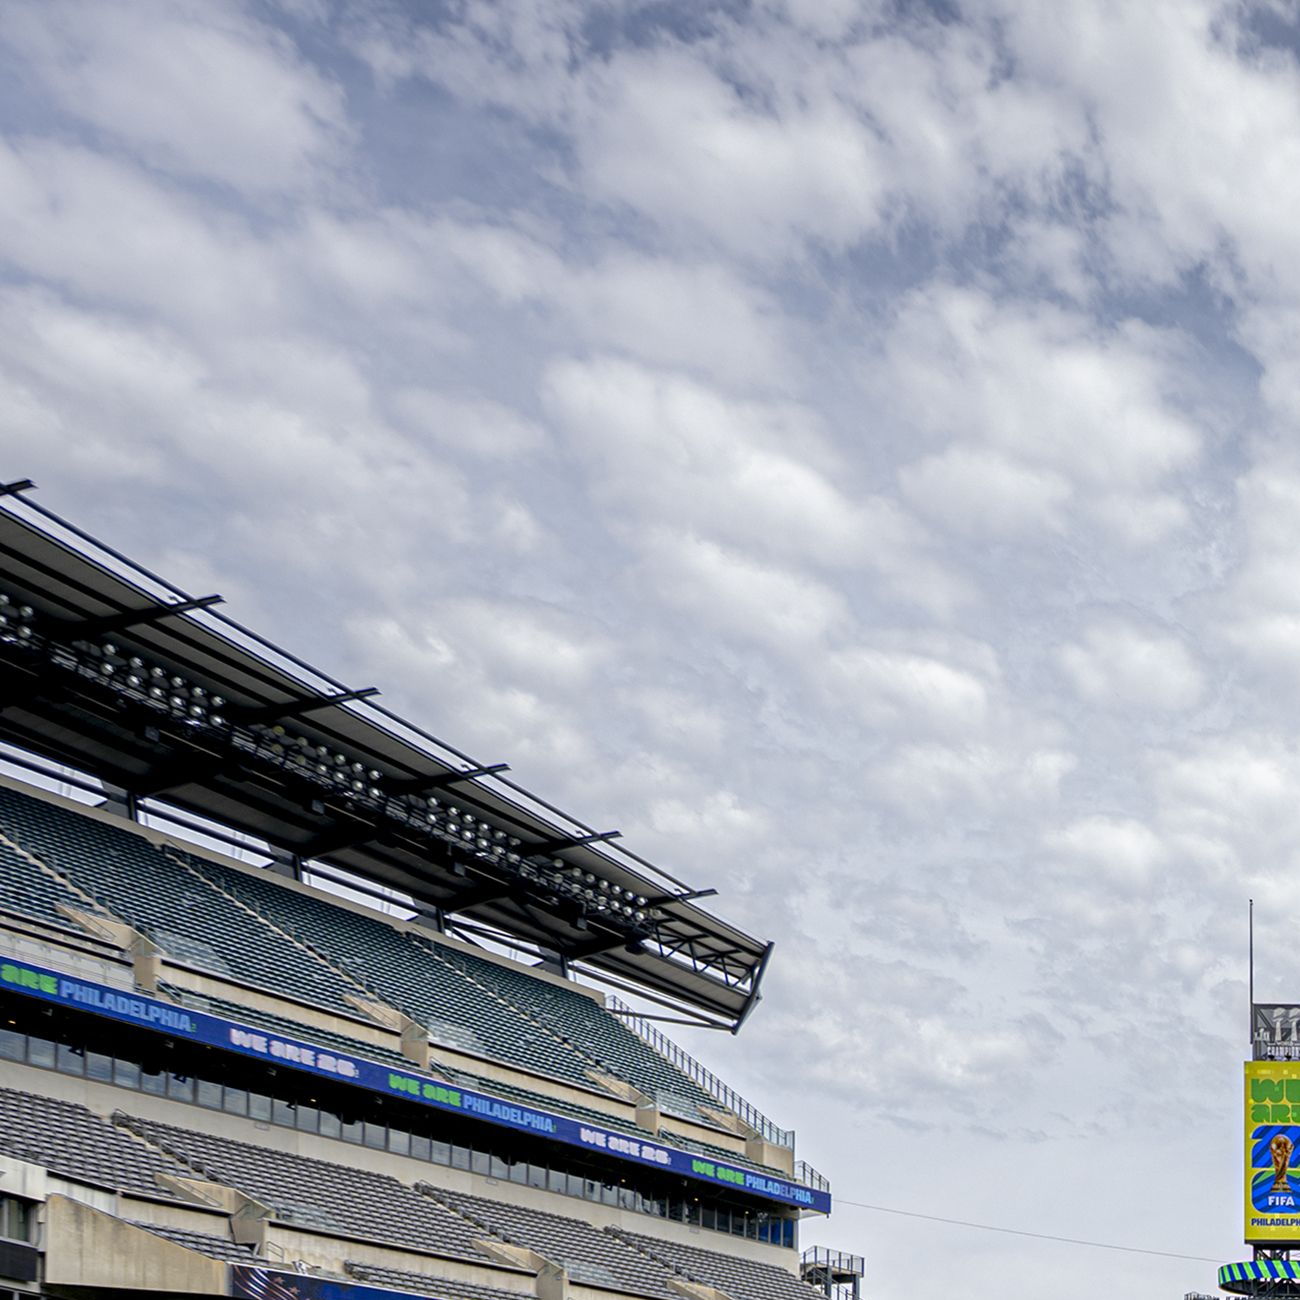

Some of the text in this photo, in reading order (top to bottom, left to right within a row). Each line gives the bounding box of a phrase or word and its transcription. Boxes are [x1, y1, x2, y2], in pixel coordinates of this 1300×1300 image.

[60, 980, 191, 1032] PHILADELPHIA
[463, 1095, 553, 1132] PHILADELPHIA
[746, 1174, 811, 1204] PHILADELPHIA
[1268, 1196, 1295, 1206] FIFA
